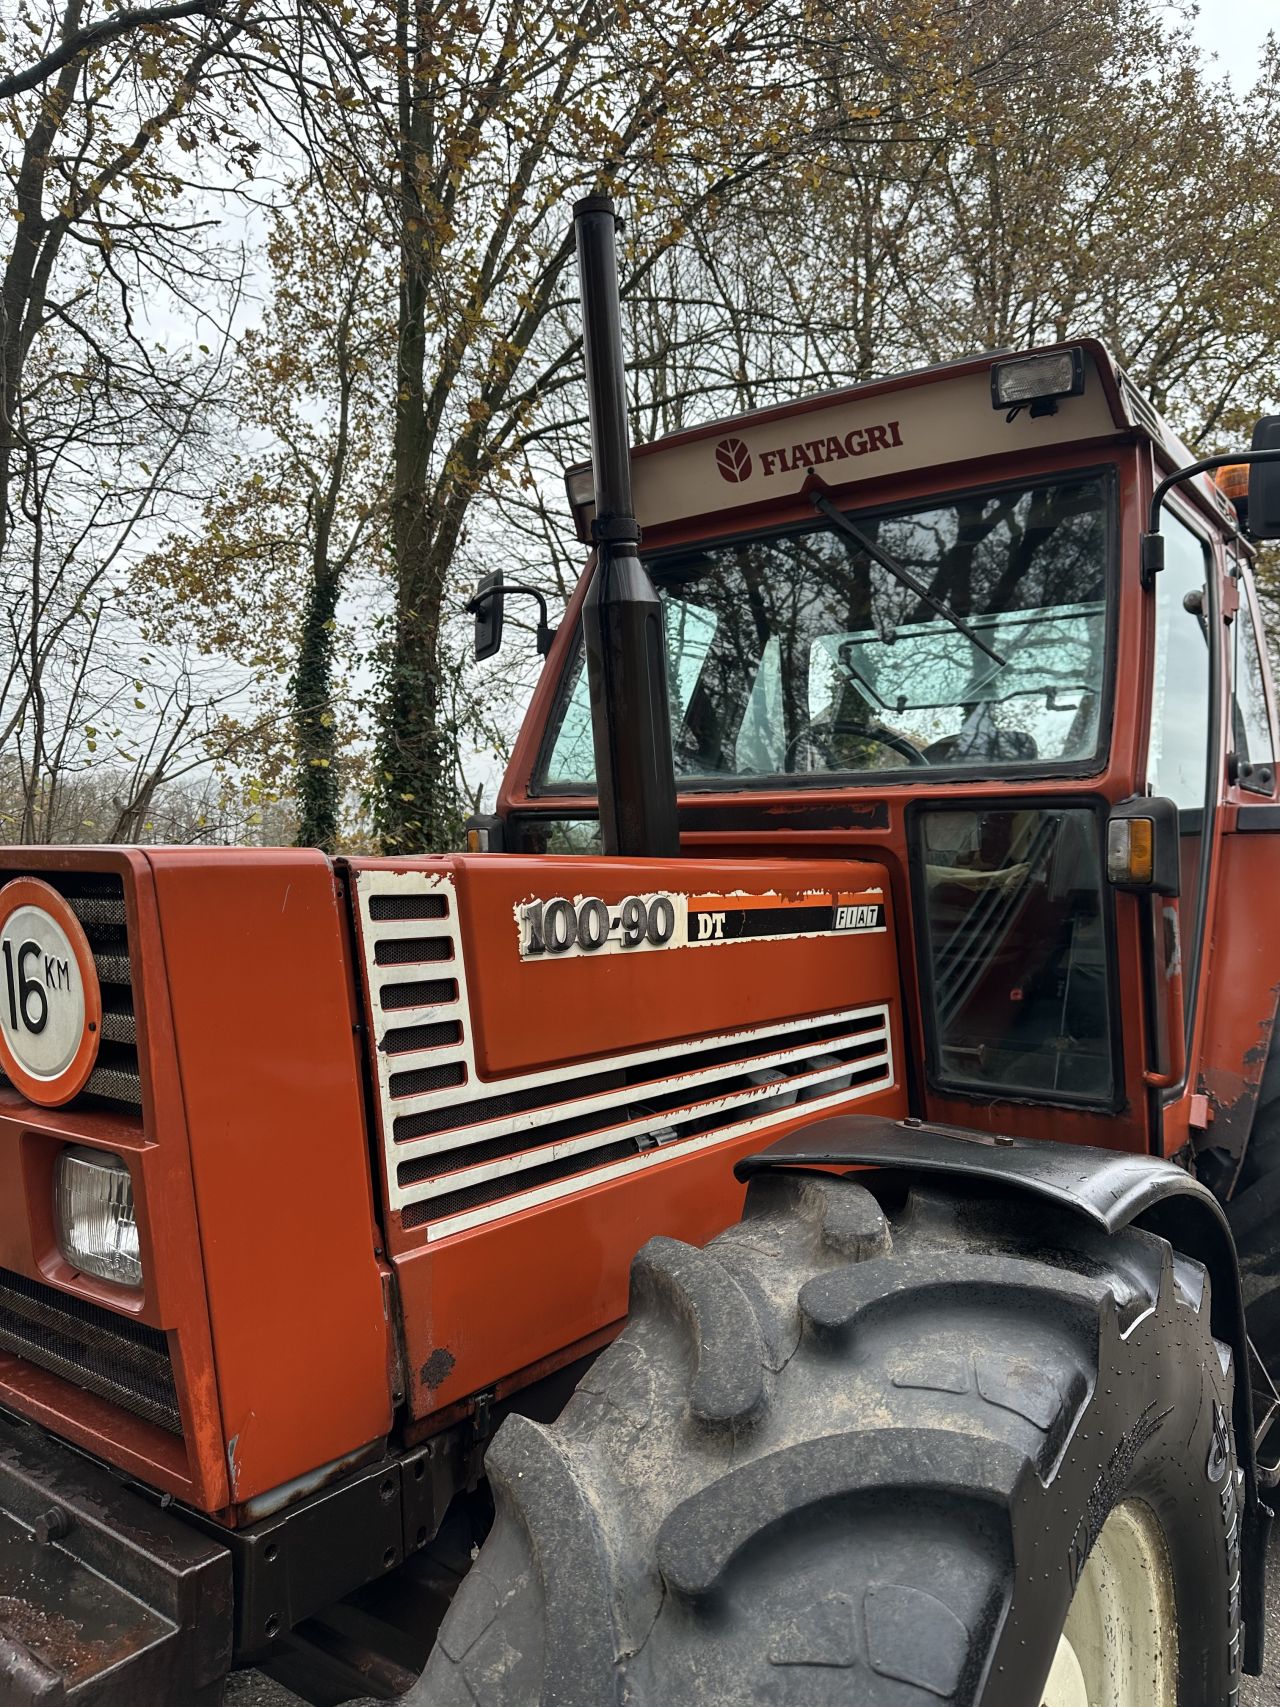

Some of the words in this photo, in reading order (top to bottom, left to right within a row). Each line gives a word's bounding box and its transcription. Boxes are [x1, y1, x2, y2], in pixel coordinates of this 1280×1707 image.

[758, 421, 904, 477] FIATAGRI
[523, 894, 675, 954] 100-90
[697, 912, 726, 940] DT
[836, 905, 879, 929] FIAT
[2, 938, 48, 1035] 16
[44, 954, 71, 992] KM
